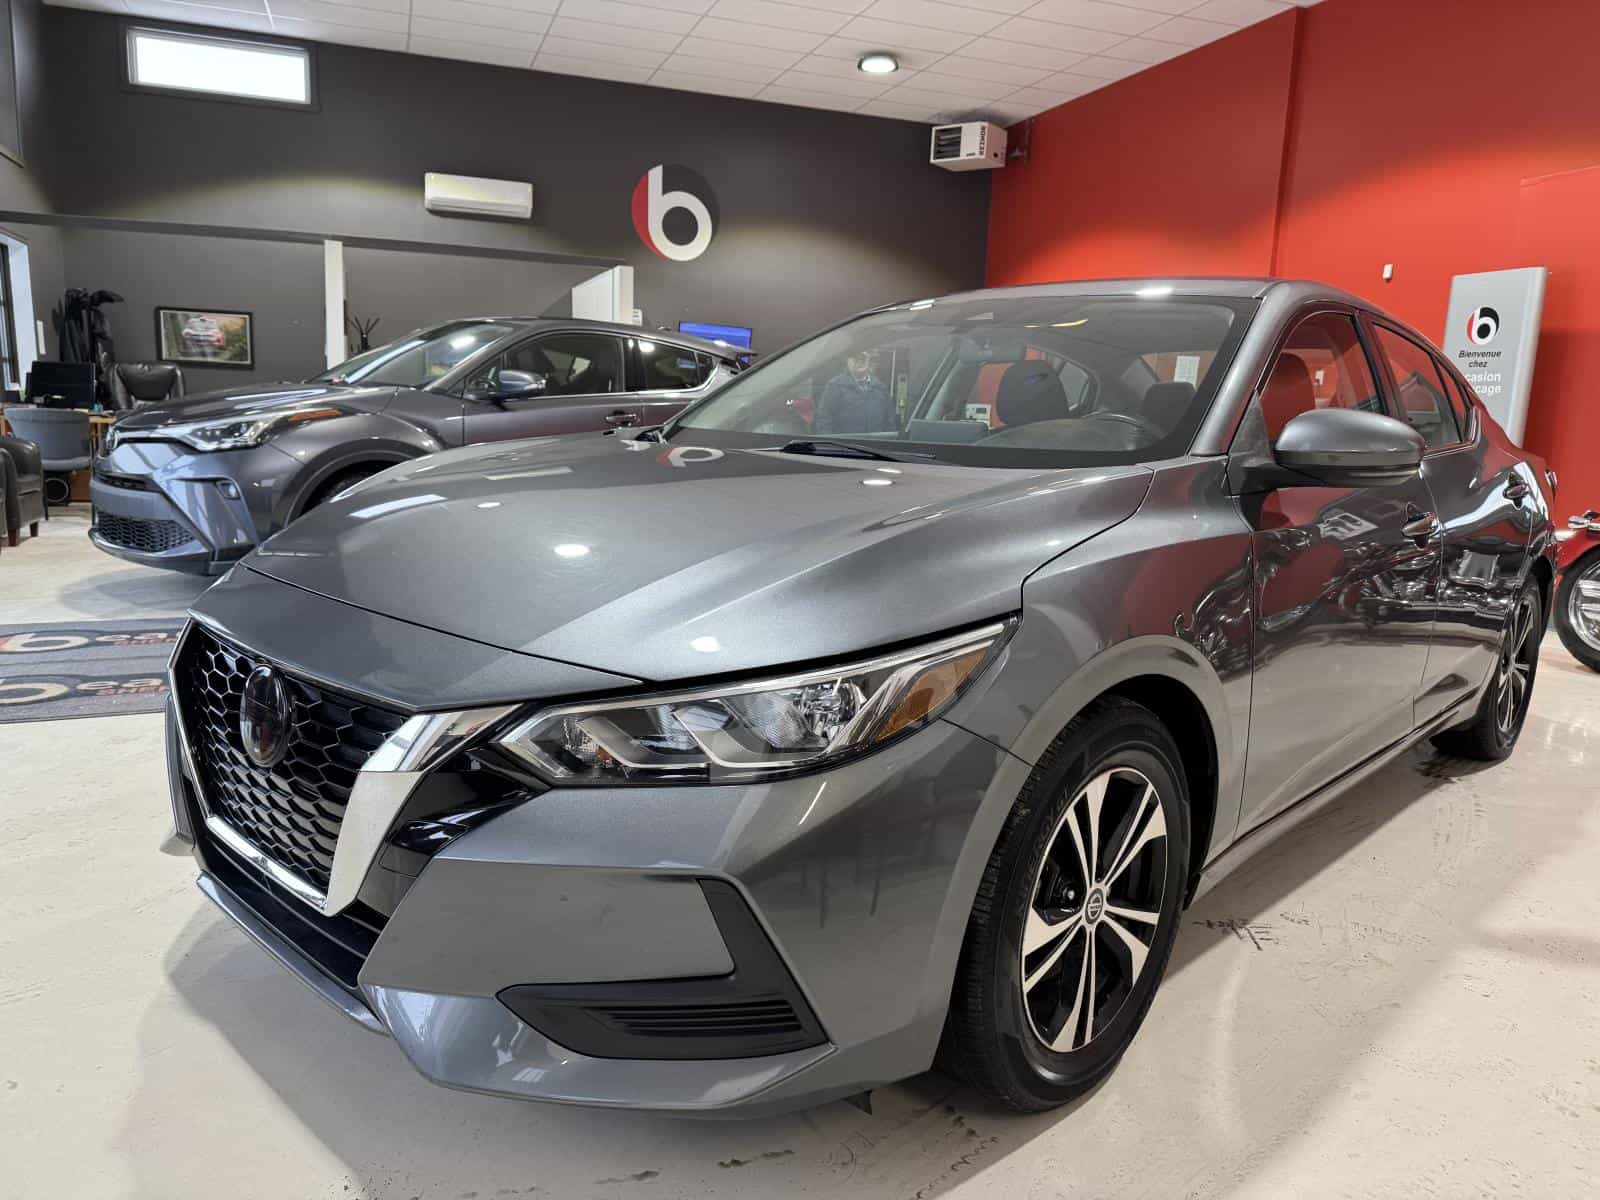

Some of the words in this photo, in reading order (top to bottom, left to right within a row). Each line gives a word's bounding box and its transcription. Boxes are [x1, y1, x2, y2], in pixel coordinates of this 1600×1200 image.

[648, 164, 712, 262] b
[1472, 306, 1497, 345] b
[1458, 350, 1502, 358] Bienvenue
[1468, 359, 1488, 368] chez
[1465, 371, 1501, 383] casion
[1473, 384, 1502, 397] cage
